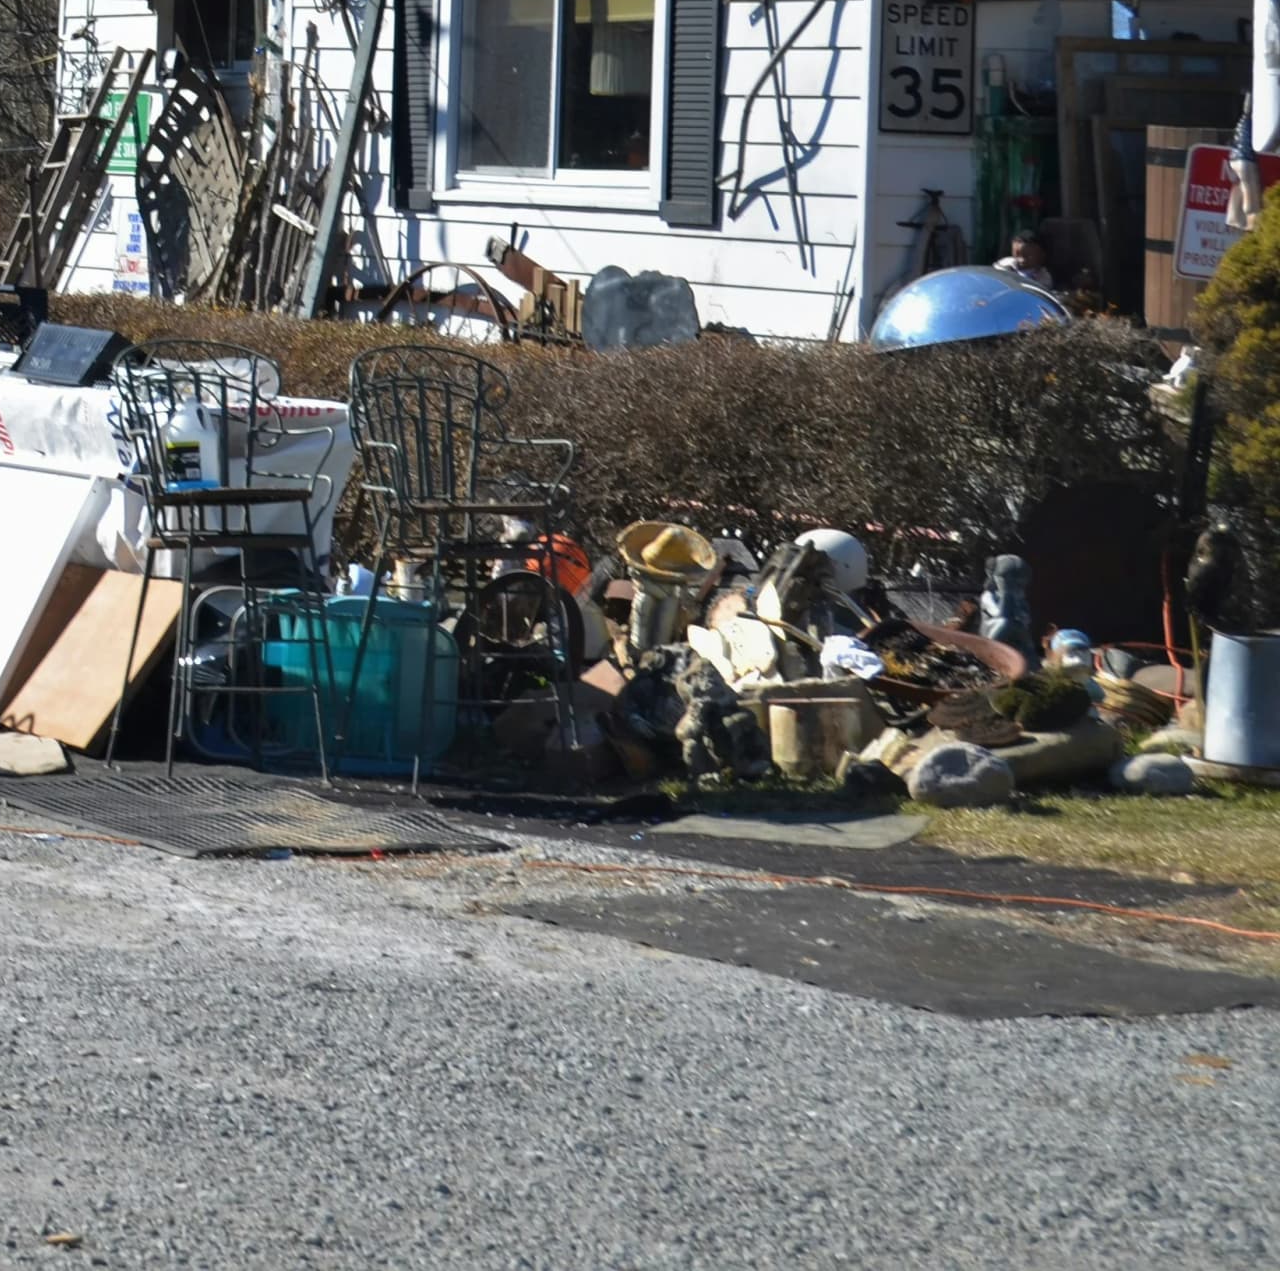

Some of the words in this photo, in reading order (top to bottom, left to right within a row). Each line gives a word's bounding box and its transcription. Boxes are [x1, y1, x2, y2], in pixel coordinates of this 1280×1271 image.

[888, 4, 969, 27] SPEED
[896, 36, 959, 57] LIMIT
[887, 65, 965, 120] 35
[1189, 184, 1231, 206] TRESP
